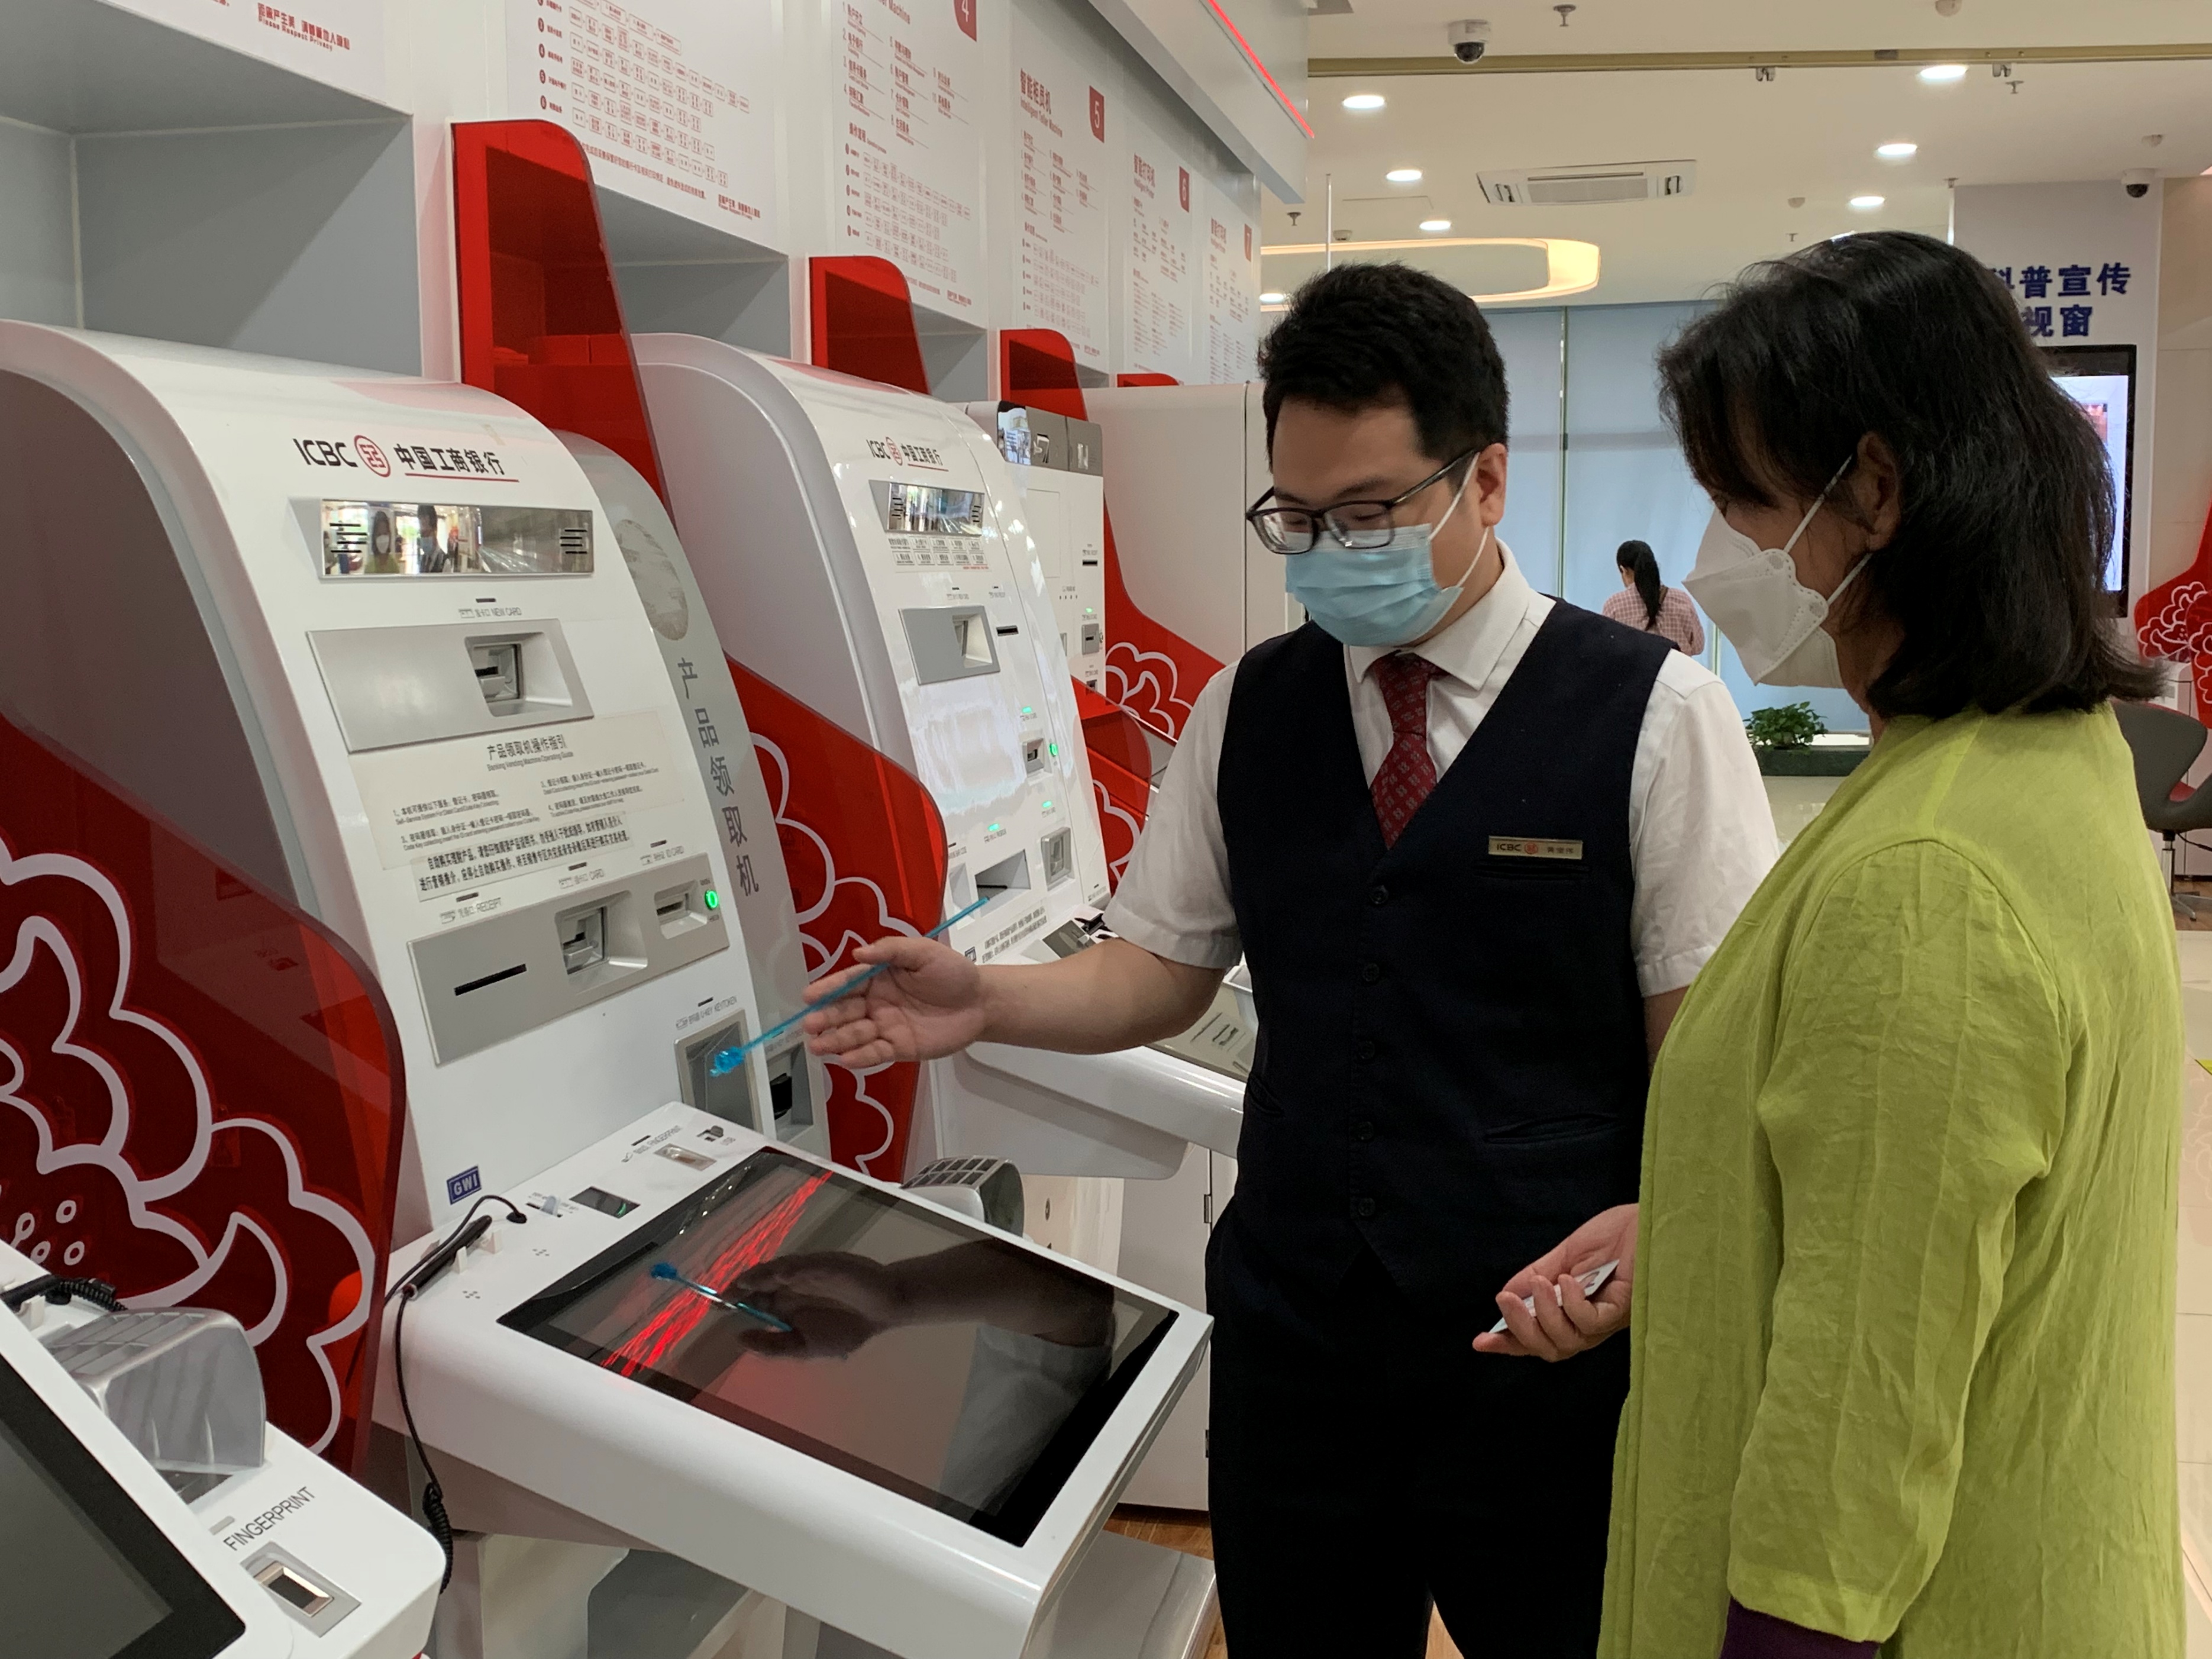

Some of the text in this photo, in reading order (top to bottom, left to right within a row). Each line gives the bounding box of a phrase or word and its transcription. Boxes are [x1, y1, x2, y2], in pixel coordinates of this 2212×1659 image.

[2020, 304, 2092, 337] 视窗
[293, 438, 359, 468] ICBC
[393, 443, 506, 475] 中国工商银行
[866, 439, 892, 460] ICBC
[677, 657, 759, 898] 产品领取机
[1496, 843, 1522, 852] ICBC
[476, 897, 501, 913] RECEIPT
[453, 1173, 478, 1196] GWI
[223, 1486, 315, 1551] FINGERPRINT
